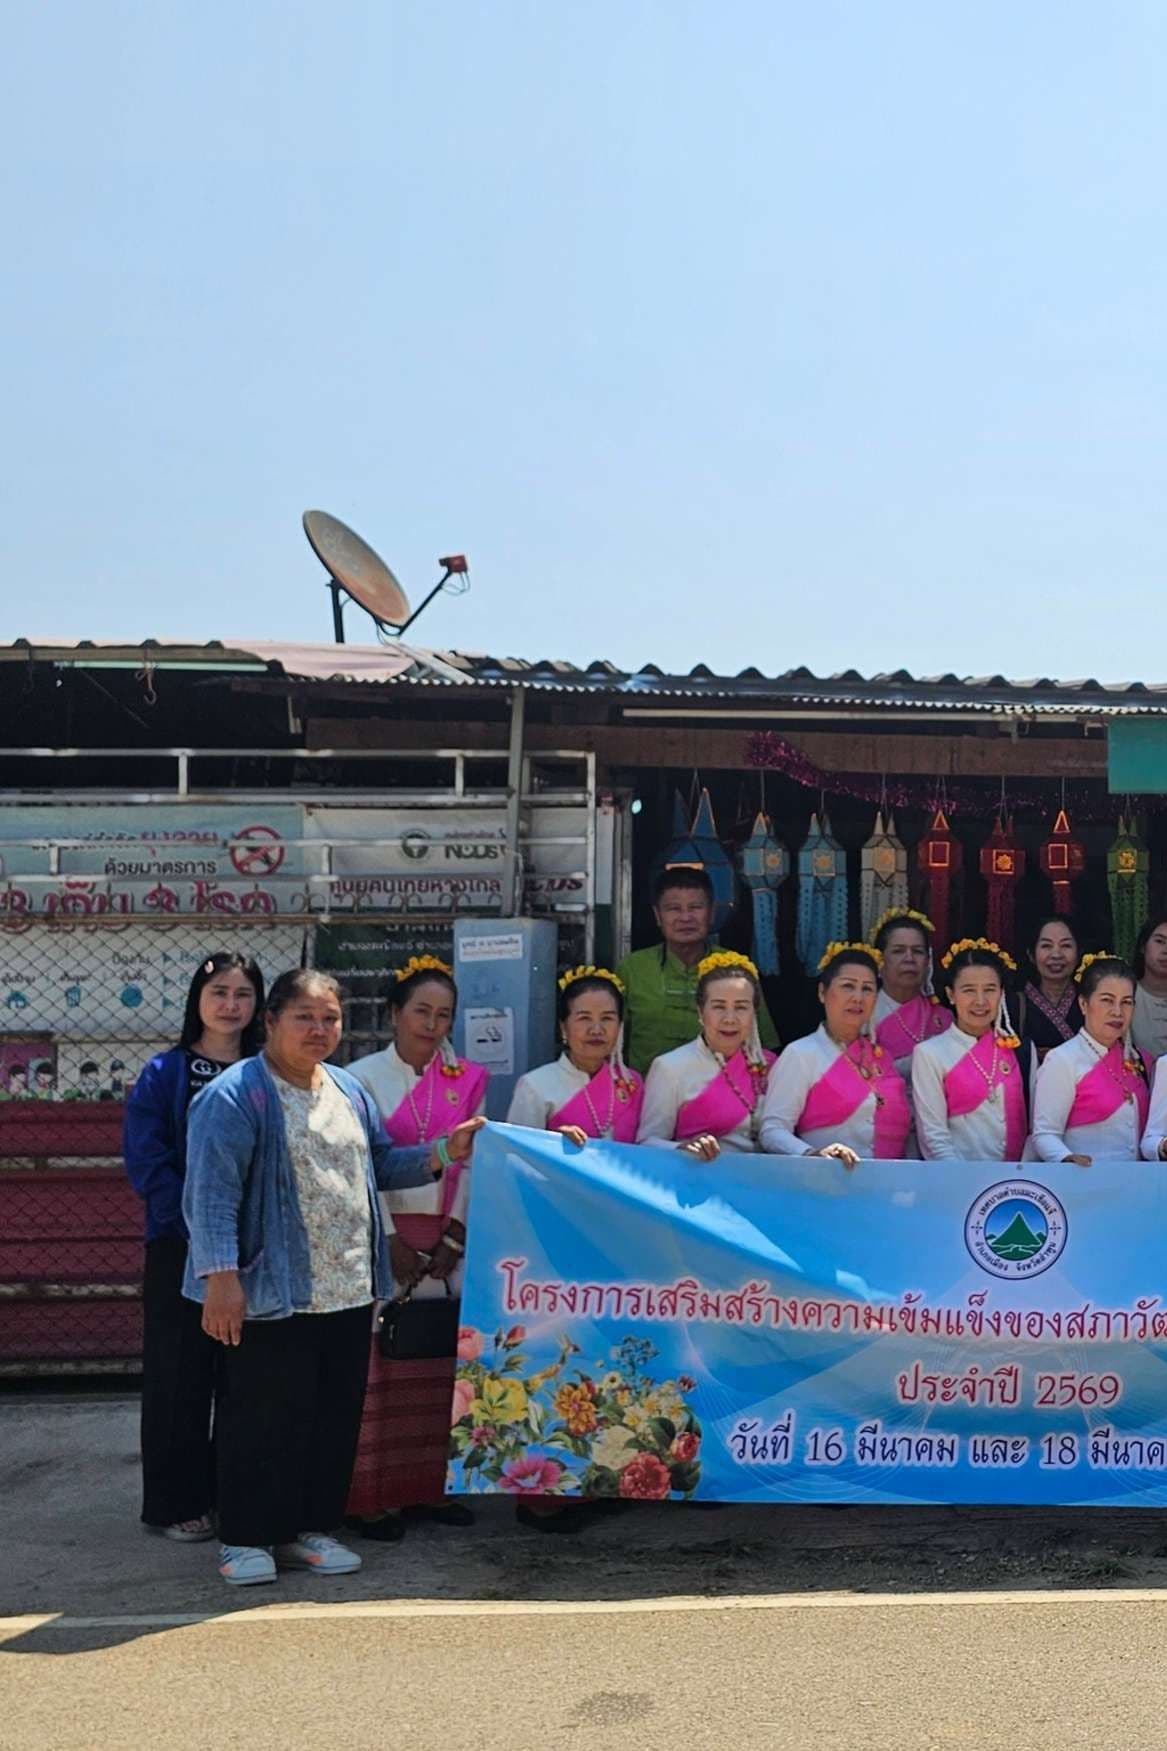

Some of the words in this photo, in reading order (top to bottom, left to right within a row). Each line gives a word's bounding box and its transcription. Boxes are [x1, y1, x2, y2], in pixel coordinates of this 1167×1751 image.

[104, 856, 217, 876] ด้วยมาตรการ
[899, 1363, 1019, 1405] ประจำปี
[1037, 1374, 1120, 1406] 2569
[730, 1413, 793, 1462] วันที่
[807, 1431, 843, 1463] 16
[858, 1423, 956, 1464] มีนาคม
[971, 1437, 1027, 1465] และ
[1042, 1435, 1077, 1466] 18
